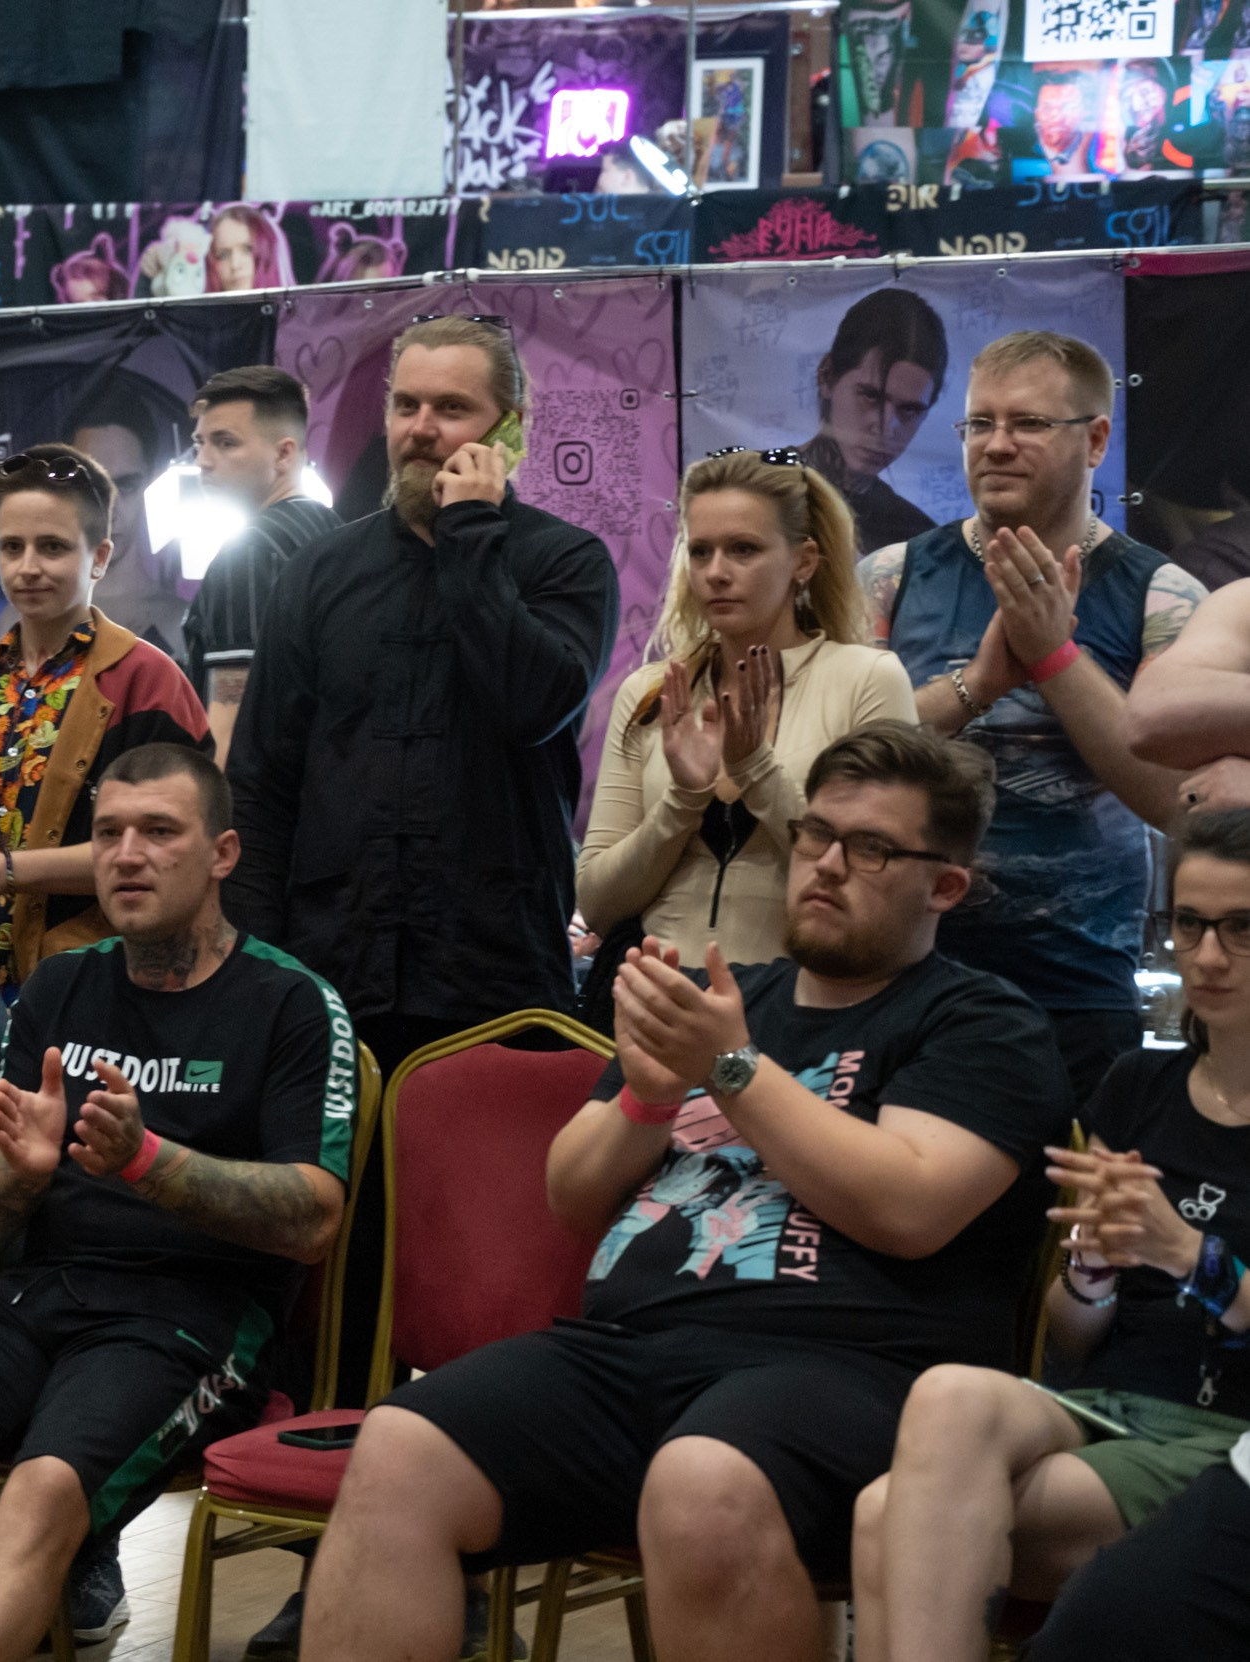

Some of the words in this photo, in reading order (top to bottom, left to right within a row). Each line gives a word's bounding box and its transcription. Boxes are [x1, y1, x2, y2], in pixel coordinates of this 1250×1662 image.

[331, 1017, 354, 1062] DO
[121, 1055, 161, 1093] DO
[182, 1083, 222, 1094] NIKE
[323, 1060, 354, 1122] JUST
[779, 1207, 822, 1282] UFFY
